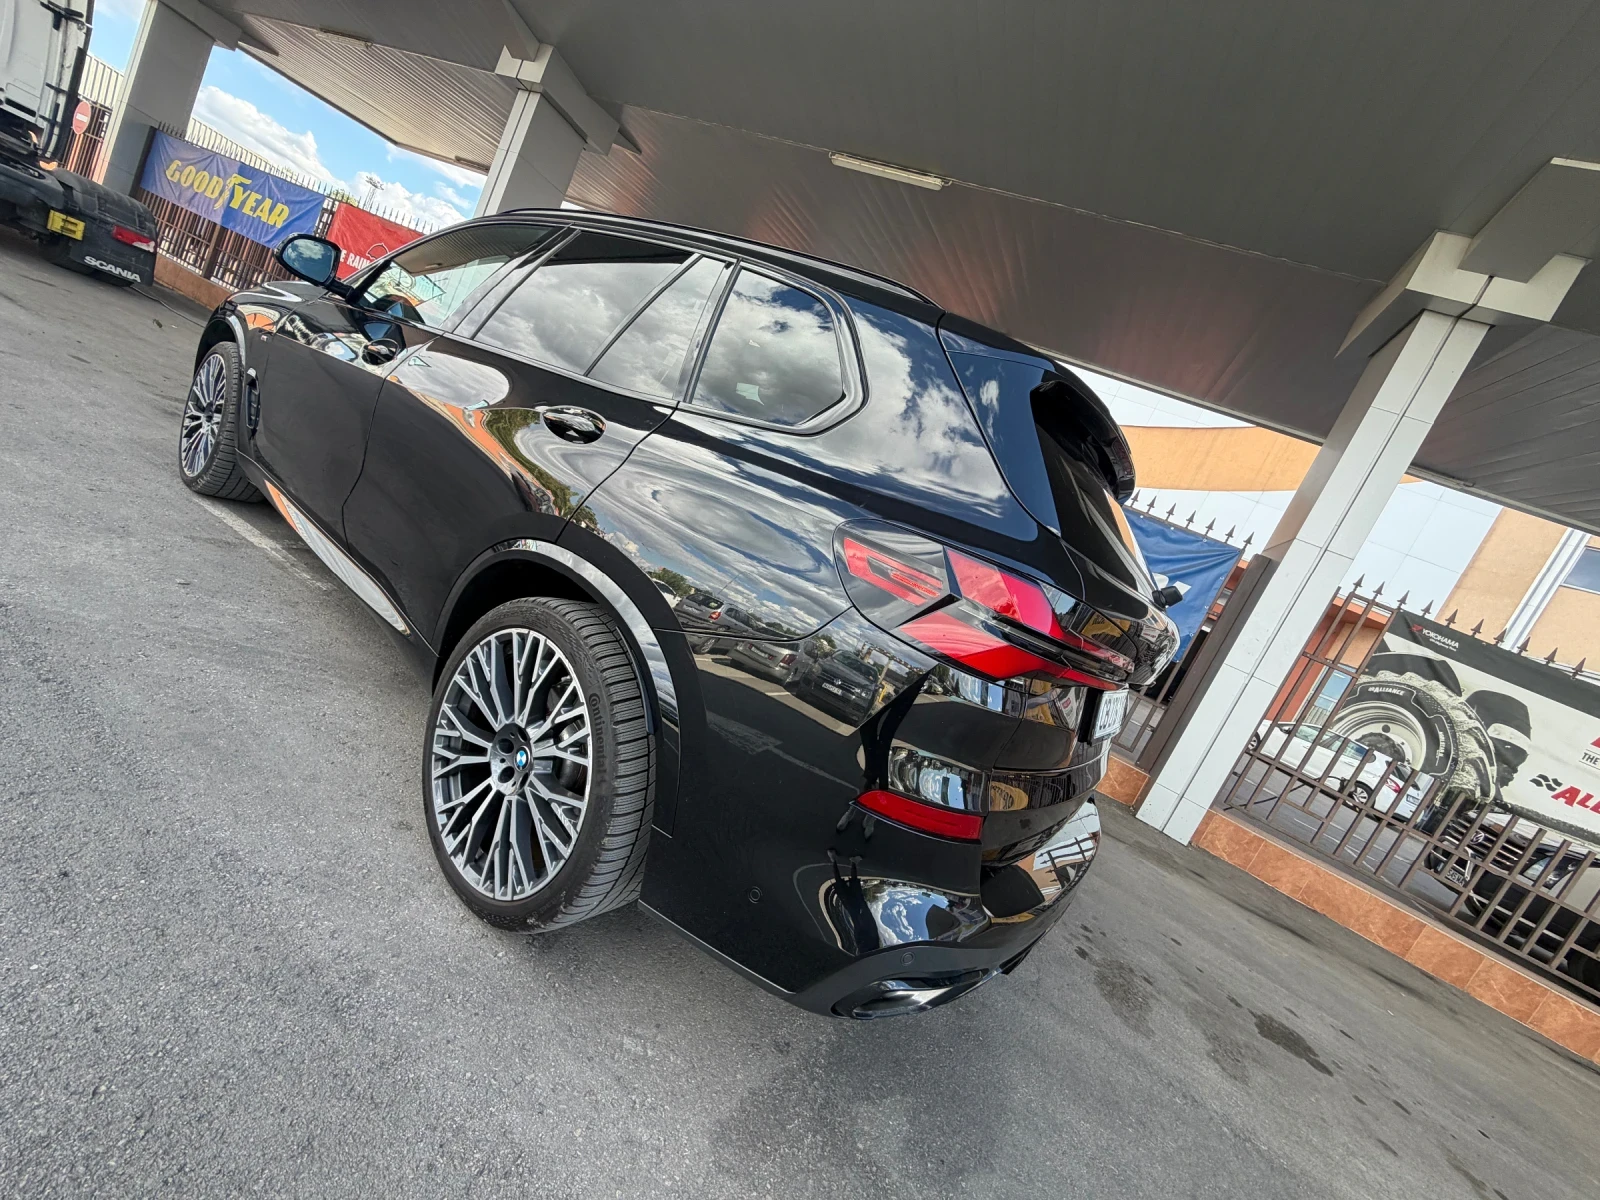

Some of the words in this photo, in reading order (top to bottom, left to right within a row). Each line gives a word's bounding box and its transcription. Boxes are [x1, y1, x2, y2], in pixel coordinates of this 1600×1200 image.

[165, 159, 290, 229] GOODYEAR
[84, 255, 141, 283] SCANIA
[1422, 628, 1460, 649] YOKOHAMA
[588, 692, 607, 774] Continental
[1581, 752, 1600, 766] THE
